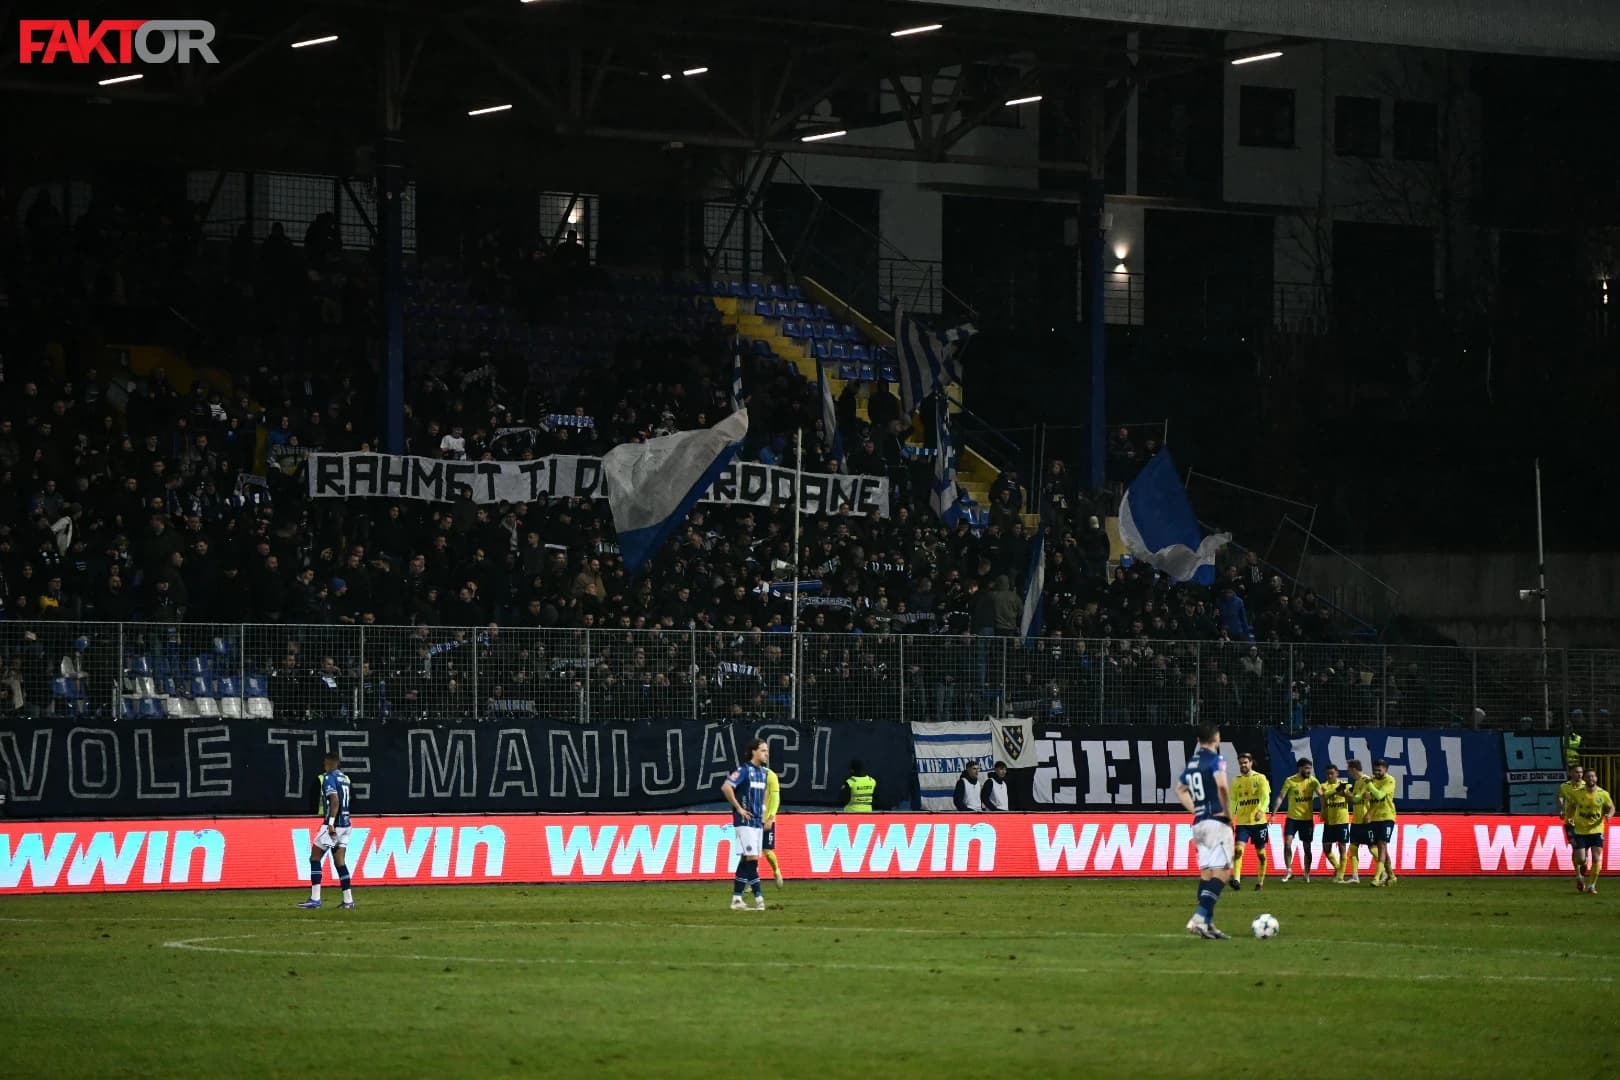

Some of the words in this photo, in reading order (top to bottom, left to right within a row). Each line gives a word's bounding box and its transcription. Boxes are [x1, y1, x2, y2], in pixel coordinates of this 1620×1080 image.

[317, 455, 501, 500] RAHMET
[519, 459, 557, 502] TI
[0, 725, 232, 801] VOLE
[268, 728, 370, 799] TE
[408, 722, 832, 799] MANIJACI
[1186, 772, 1206, 801] 19
